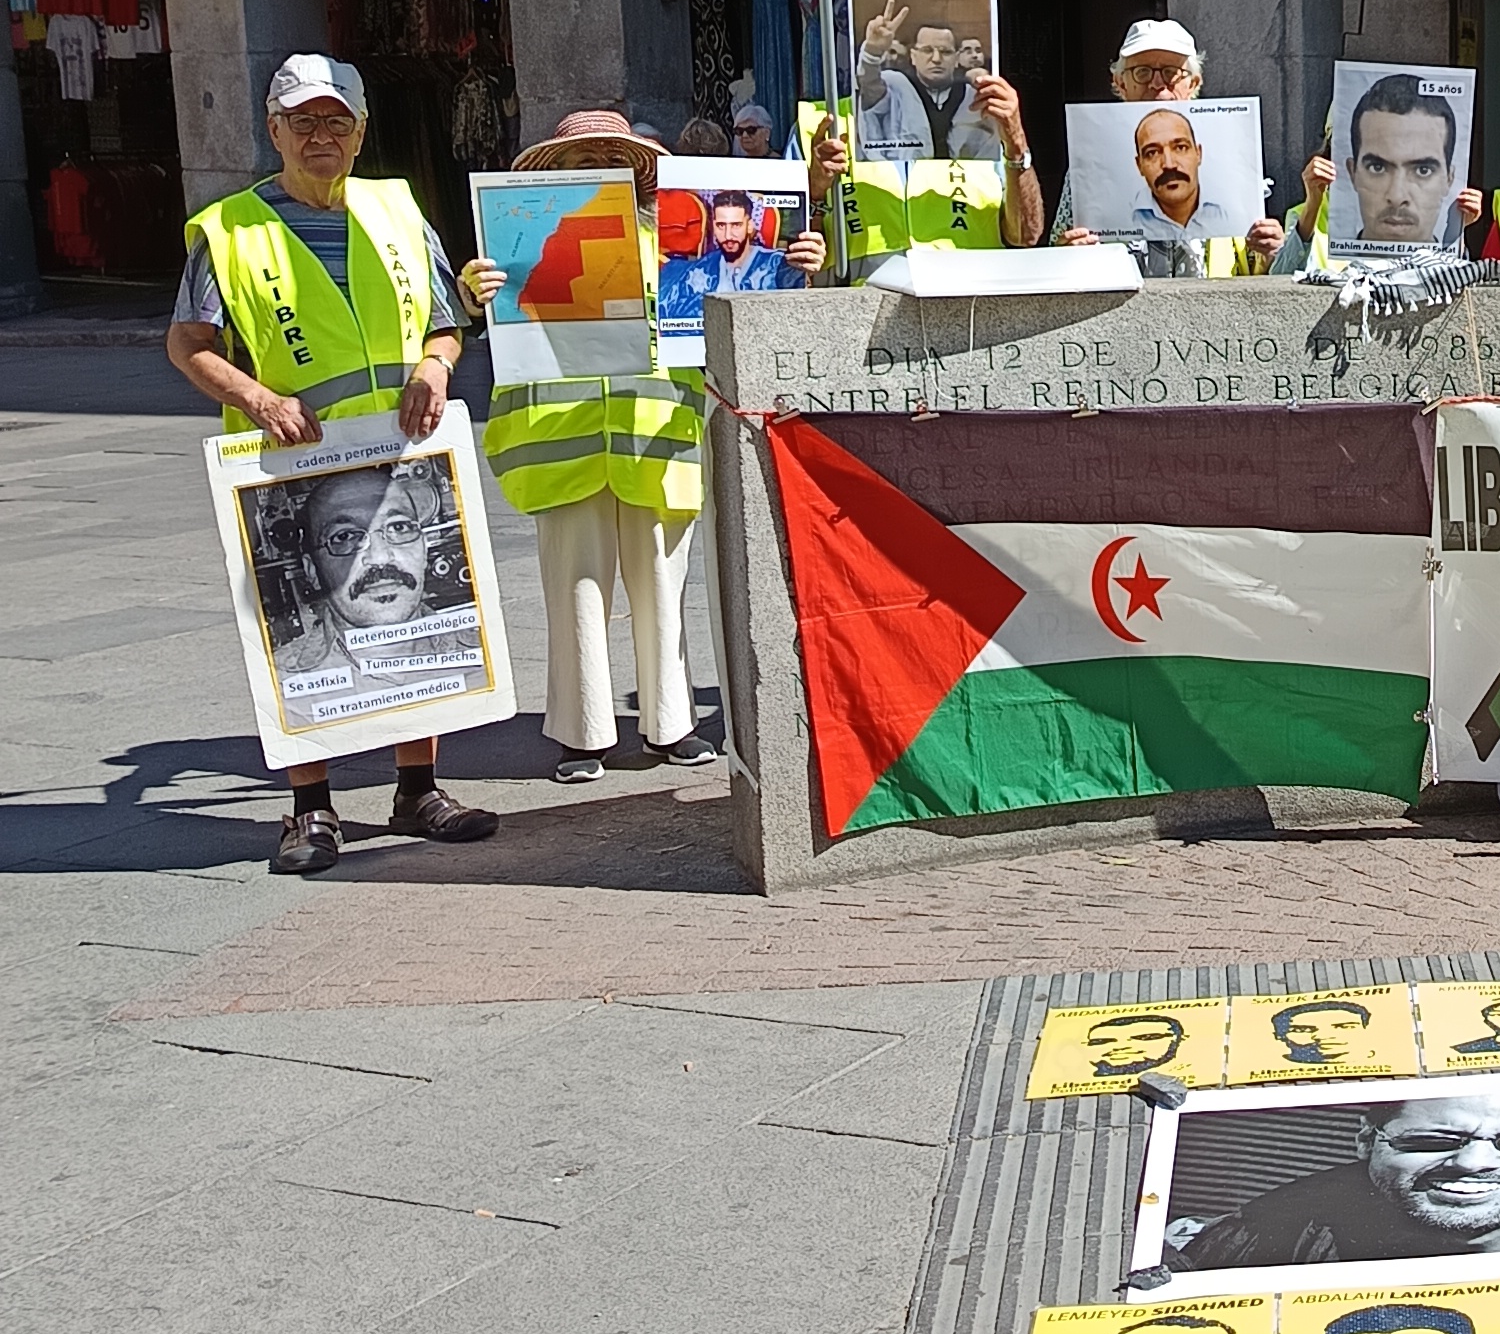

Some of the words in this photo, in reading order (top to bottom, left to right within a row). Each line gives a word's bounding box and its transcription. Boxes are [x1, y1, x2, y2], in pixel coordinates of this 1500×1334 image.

[1422, 83, 1435, 93] 15
[1438, 83, 1463, 94] años
[1190, 106, 1216, 114] Cadena
[1217, 105, 1248, 115] Perpetua
[1330, 241, 1361, 251] Brahim
[1363, 243, 1395, 252] Ahmed
[263, 268, 313, 366] LIBRE
[774, 351, 827, 381] EL
[868, 347, 946, 376] DIA
[986, 344, 1022, 369] 12
[1060, 340, 1116, 367] DE
[1313, 336, 1366, 363] DE
[952, 385, 1004, 411] EL
[1032, 378, 1168, 408] REINO
[1196, 375, 1246, 403] DE
[222, 440, 270, 456] BRAHIM
[296, 453, 341, 469] cadena
[345, 442, 401, 463] perpetua
[350, 628, 407, 645] deterioro
[410, 614, 476, 636] psicológico
[365, 657, 405, 670] Tumor
[409, 656, 423, 666] en
[427, 653, 438, 665] el
[441, 651, 477, 668] pecho
[289, 681, 304, 693] Se
[308, 675, 347, 690] asfixia
[318, 706, 337, 718] Sin
[340, 688, 413, 713] tratamiento
[416, 679, 460, 697] médico
[1313, 987, 1392, 1001] LAASIRI
[1144, 1001, 1220, 1012] TOUBALI
[1292, 1290, 1385, 1305] ABDALAHI
[1047, 1308, 1147, 1323] LEMJEYED
[1151, 1297, 1264, 1317] SIDAHMED
